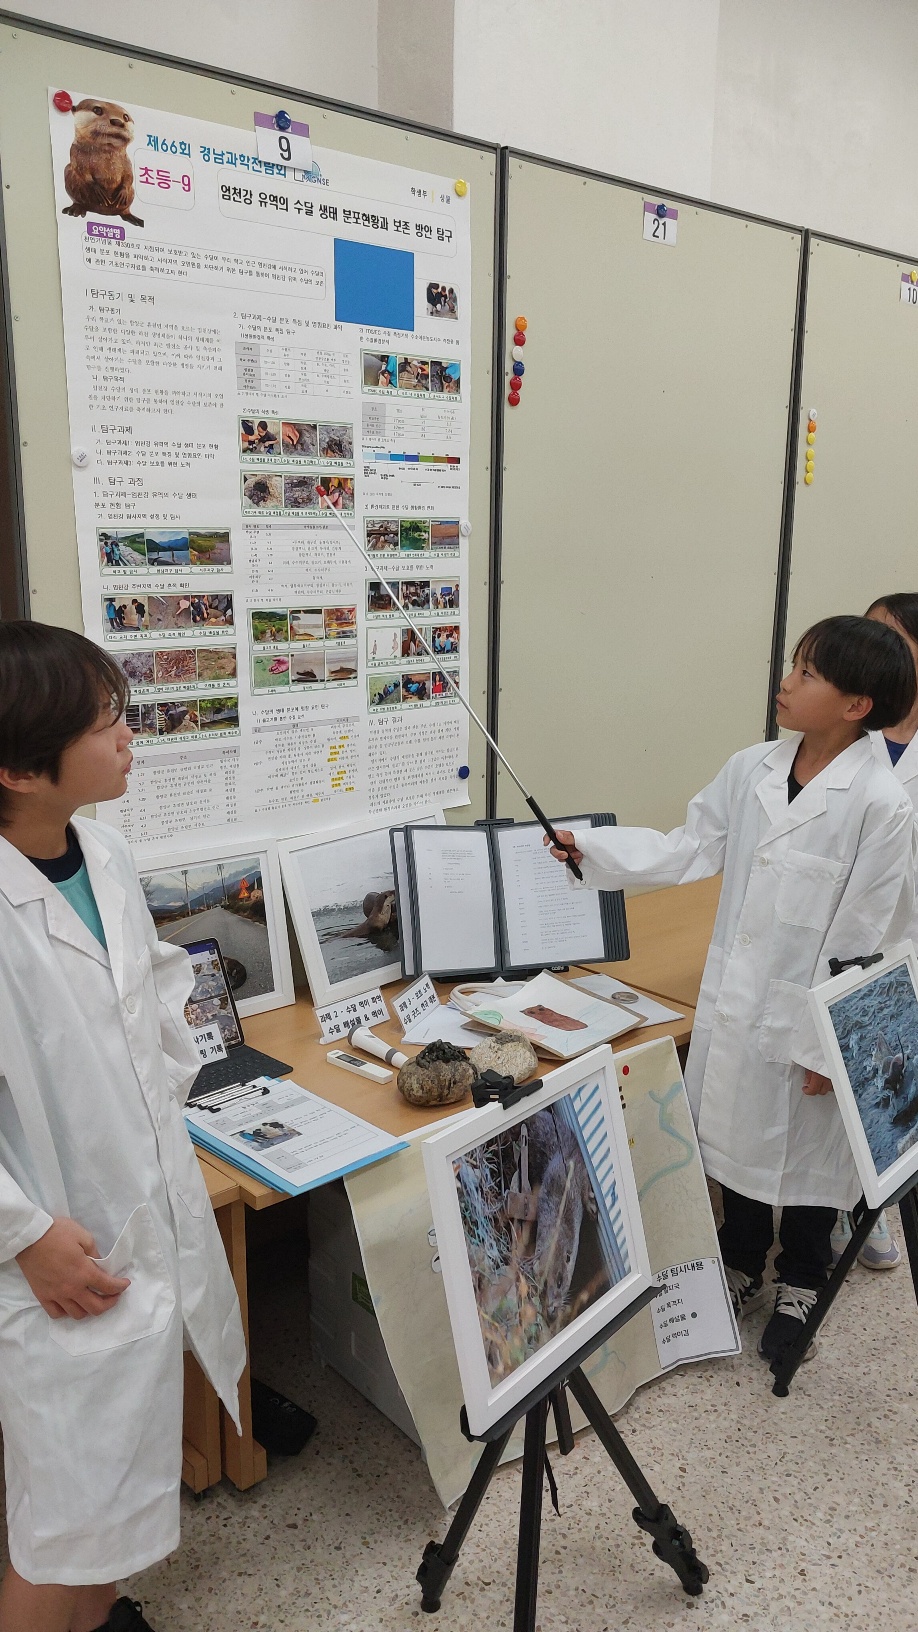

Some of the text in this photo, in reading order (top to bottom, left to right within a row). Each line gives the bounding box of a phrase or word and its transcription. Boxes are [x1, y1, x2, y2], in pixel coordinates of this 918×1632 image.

[146, 134, 191, 158] 제66회
[278, 136, 291, 161] 9
[139, 166, 191, 192] 초등-9
[221, 184, 453, 243] 엄천강 유역의 수달 생태 분포현황과 보존 방안 탐구
[92, 226, 120, 238] 요약설명
[652, 218, 666, 240] 21
[908, 287, 917, 304] 10
[319, 1012, 332, 1023] 과제
[346, 1001, 357, 1014] 수달
[329, 1025, 341, 1035] 수달
[210, 1044, 223, 1054] 기록
